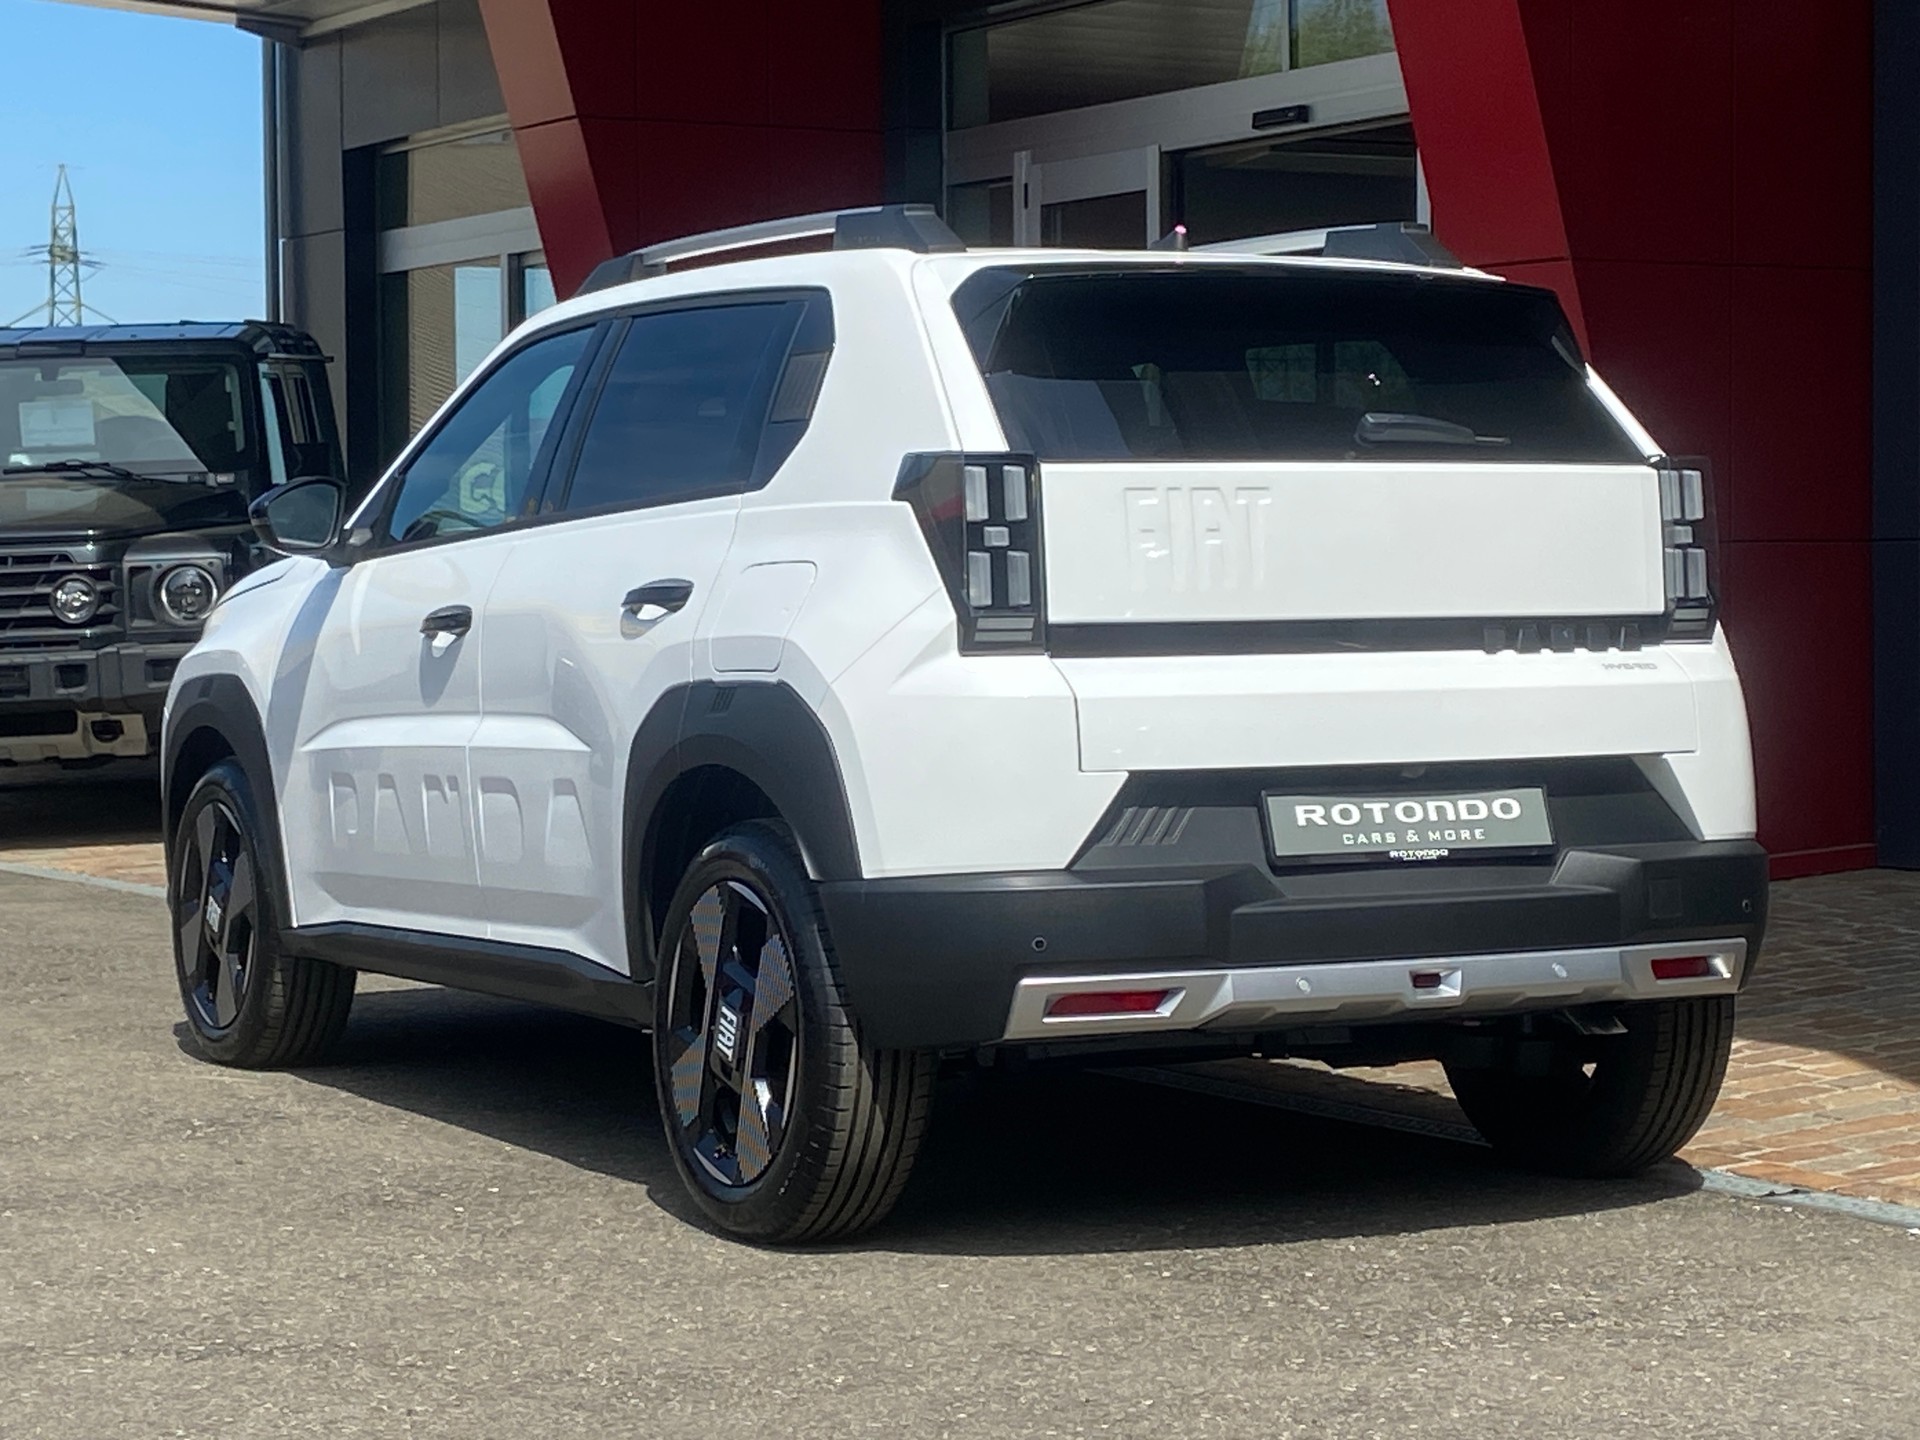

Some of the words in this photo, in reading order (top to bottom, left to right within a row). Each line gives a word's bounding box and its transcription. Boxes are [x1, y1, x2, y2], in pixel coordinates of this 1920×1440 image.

[1123, 486, 1273, 592] FIAT
[1601, 662, 1658, 670] HYBRID
[328, 770, 595, 868] PANDA
[1294, 797, 1522, 827] ROTONDO
[1342, 831, 1396, 845] CARS
[1405, 829, 1420, 843] &
[1428, 828, 1486, 841] MORE
[717, 1005, 737, 1061] FIAT
